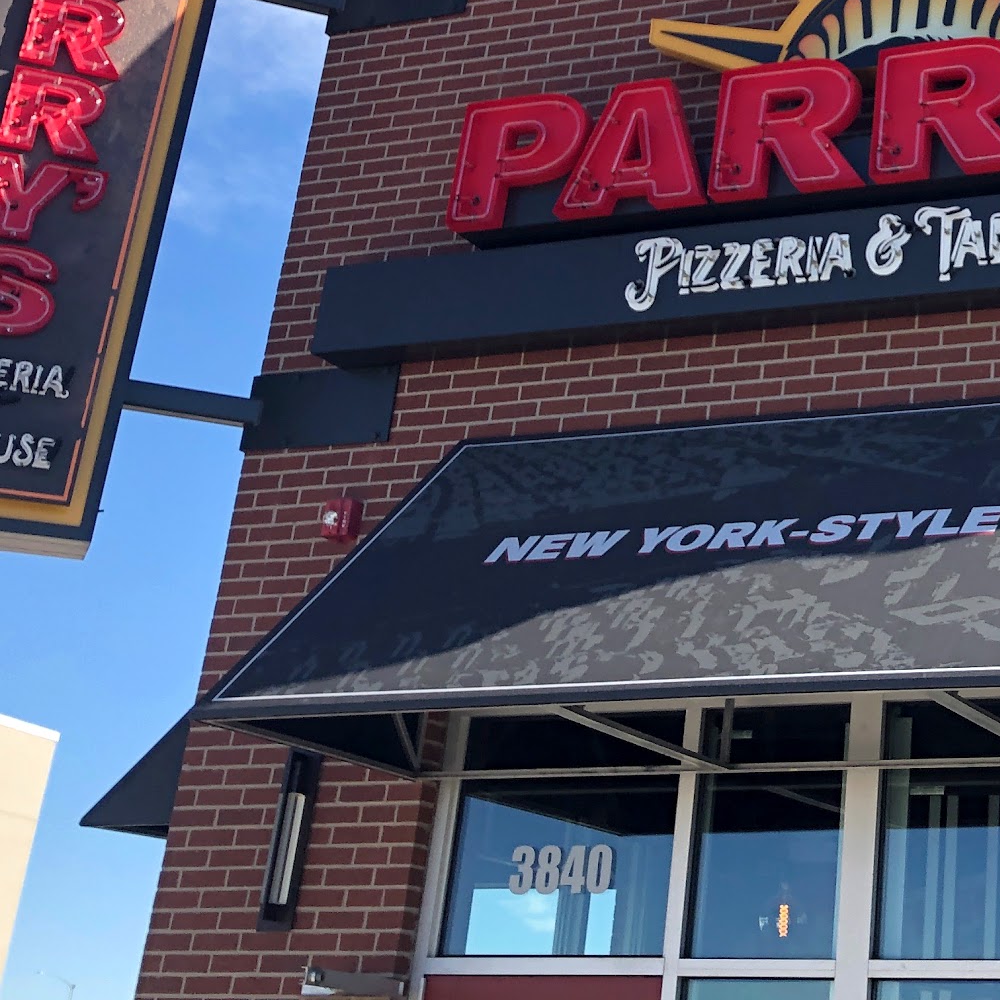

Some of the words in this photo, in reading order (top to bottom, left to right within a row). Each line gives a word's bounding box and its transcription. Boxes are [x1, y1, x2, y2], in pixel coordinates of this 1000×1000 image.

[624, 232, 853, 312] PIZZERIA
[865, 213, 912, 276] &
[484, 529, 627, 565] NEW
[508, 843, 613, 895] 3840
